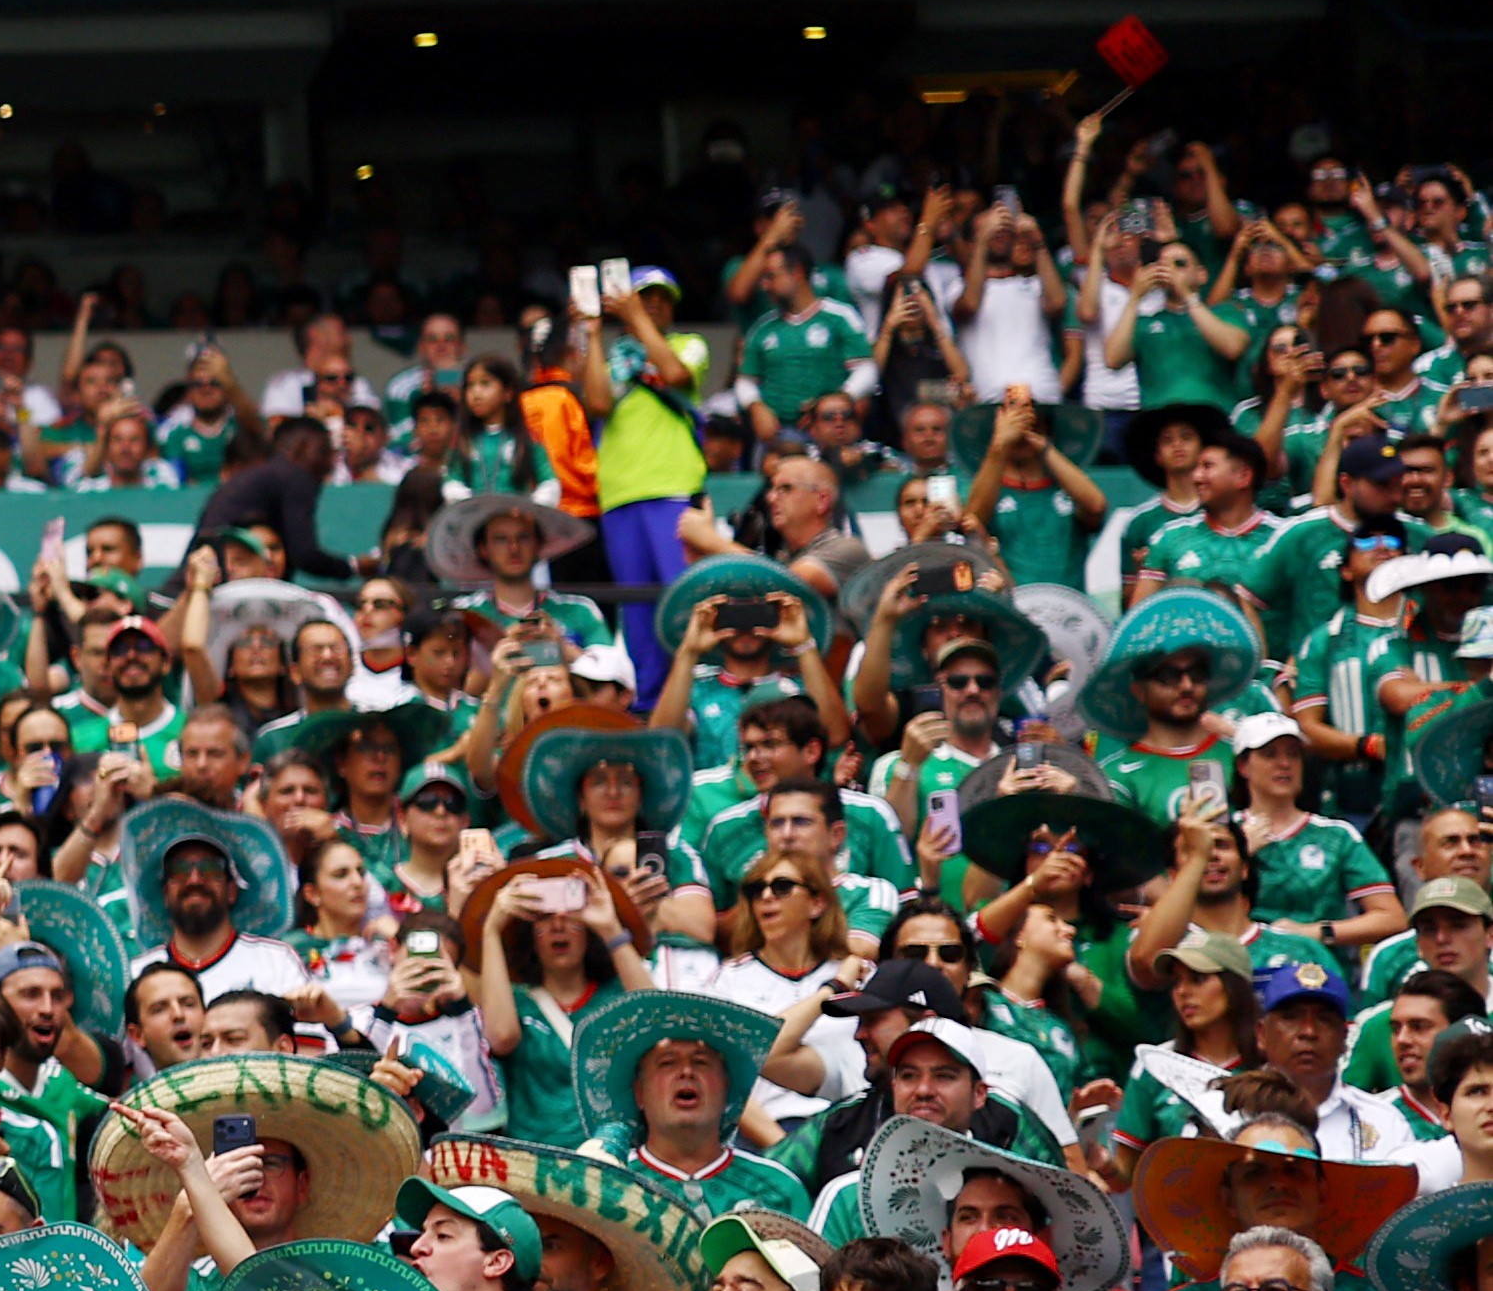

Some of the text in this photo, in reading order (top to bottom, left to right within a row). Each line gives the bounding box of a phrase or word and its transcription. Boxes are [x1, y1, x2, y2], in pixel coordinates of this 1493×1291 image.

[7, 1233, 31, 1247] FIFA
[77, 1227, 103, 1243] FIFA
[335, 1243, 363, 1259] FIFA
